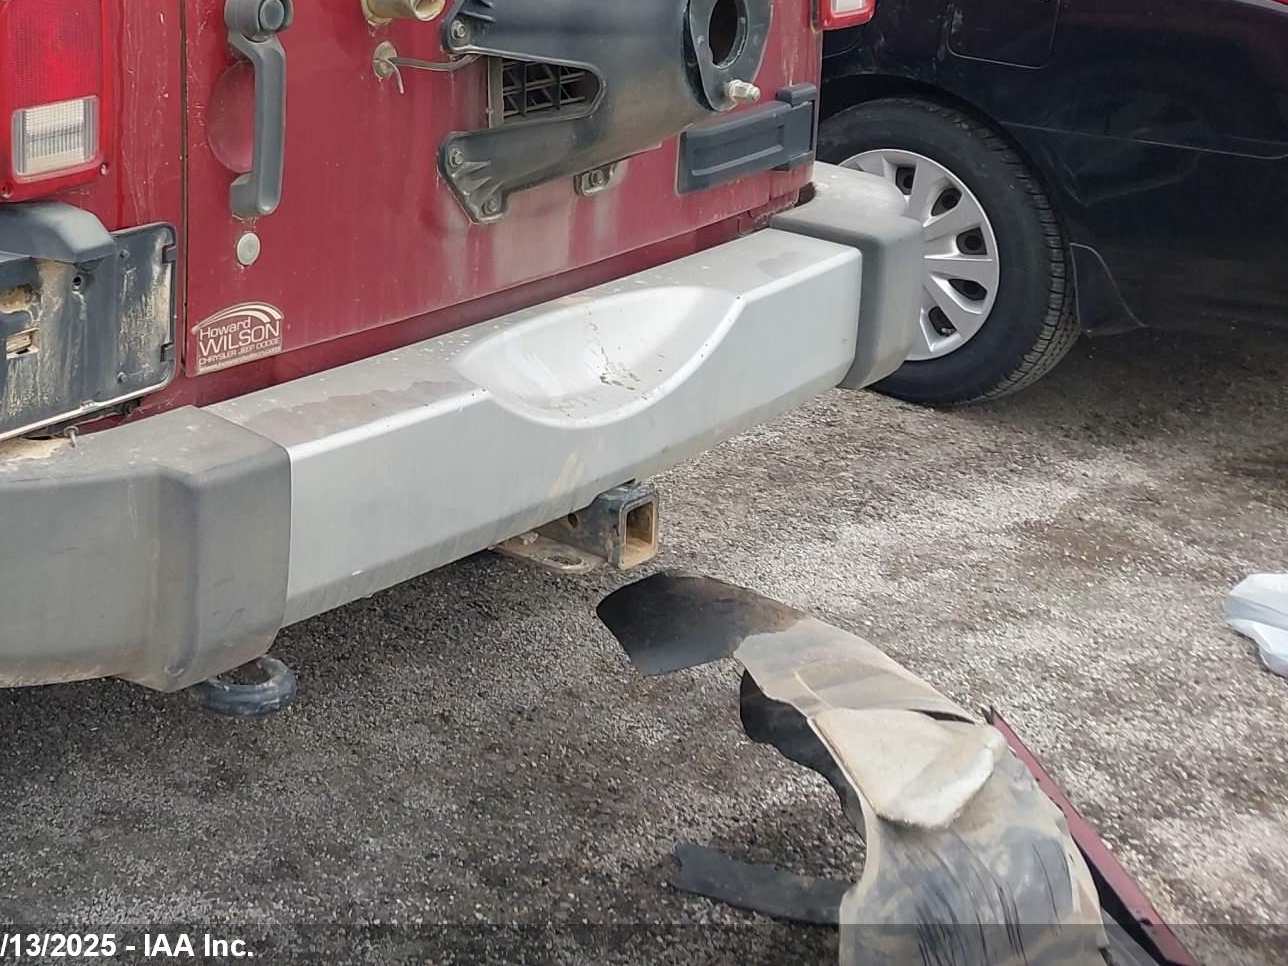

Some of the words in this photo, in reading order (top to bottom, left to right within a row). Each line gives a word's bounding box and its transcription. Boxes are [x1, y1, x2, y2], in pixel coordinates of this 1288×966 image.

[199, 316, 252, 340] Howard
[199, 320, 280, 356] WILSON
[199, 349, 238, 365] CHRYSLER
[255, 337, 281, 350] DODGE
